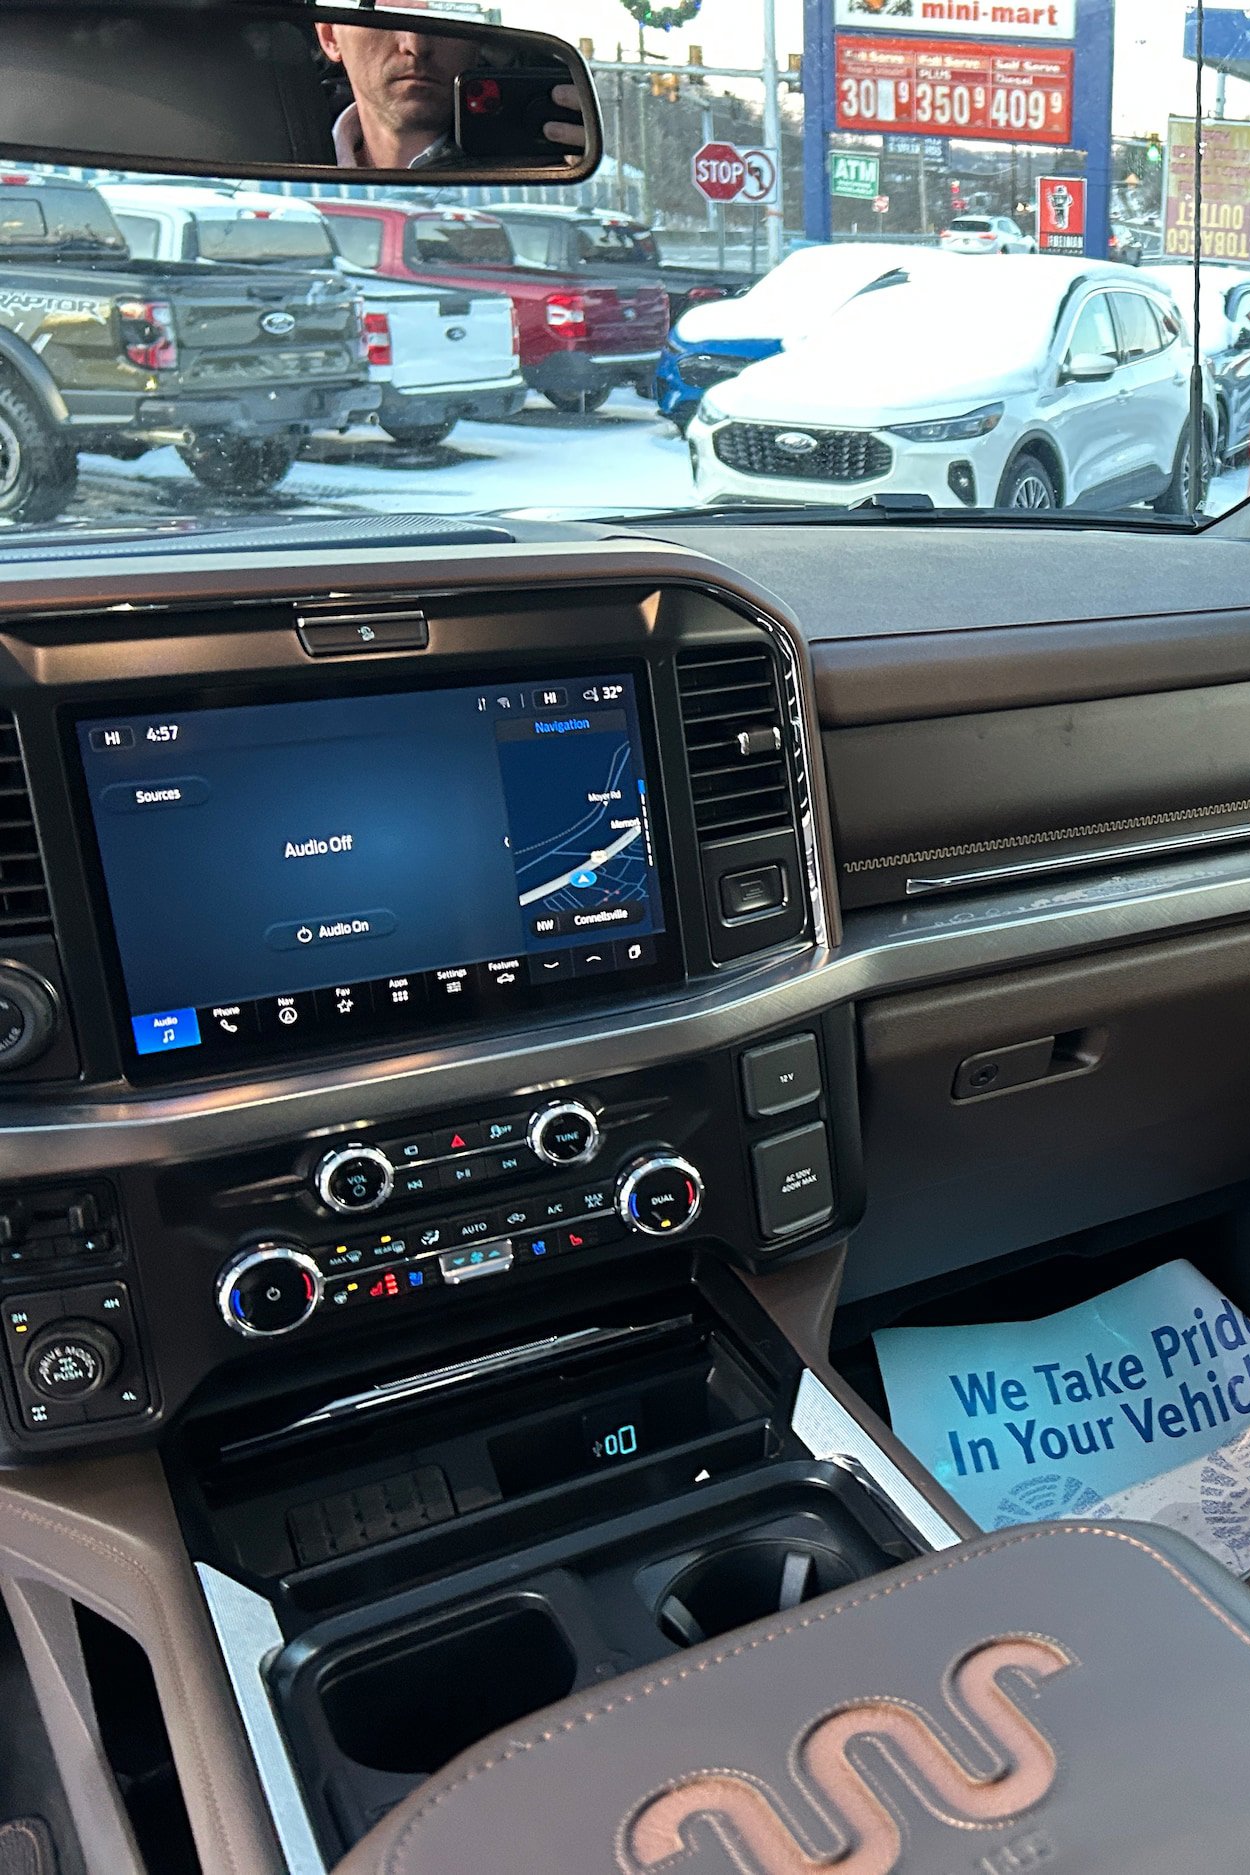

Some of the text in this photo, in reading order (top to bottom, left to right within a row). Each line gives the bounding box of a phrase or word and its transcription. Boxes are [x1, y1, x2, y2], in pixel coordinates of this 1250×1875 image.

[921, 0, 1058, 25] mini-mart
[1022, 61, 1061, 73] Serve
[696, 160, 744, 184] STOP
[835, 158, 877, 184] ATM
[543, 692, 557, 705] HI
[534, 718, 590, 734] Navigation
[104, 730, 121, 746] HI
[146, 725, 178, 742] 4:57
[135, 788, 181, 804] Sources
[610, 790, 622, 799] Rd
[285, 834, 353, 859] Audio Off
[574, 909, 628, 926] Connellsville
[319, 920, 369, 939] Audio On
[536, 920, 554, 932] NW
[488, 959, 519, 972] Features
[437, 968, 467, 981] Settings
[389, 978, 408, 989] Apps
[335, 988, 350, 997] Fav
[278, 998, 294, 1007] Nav
[213, 1006, 240, 1018] Phone
[153, 1016, 178, 1028] Audio
[555, 1131, 579, 1143] TUNE
[347, 1175, 367, 1185] VOL
[651, 1194, 675, 1206] DUAL
[547, 1204, 564, 1215] A/C
[461, 1222, 487, 1236] AUTO
[949, 1369, 1028, 1417] We
[1034, 1353, 1145, 1405] Take
[948, 1429, 999, 1476] In
[1005, 1416, 1114, 1464] Your
